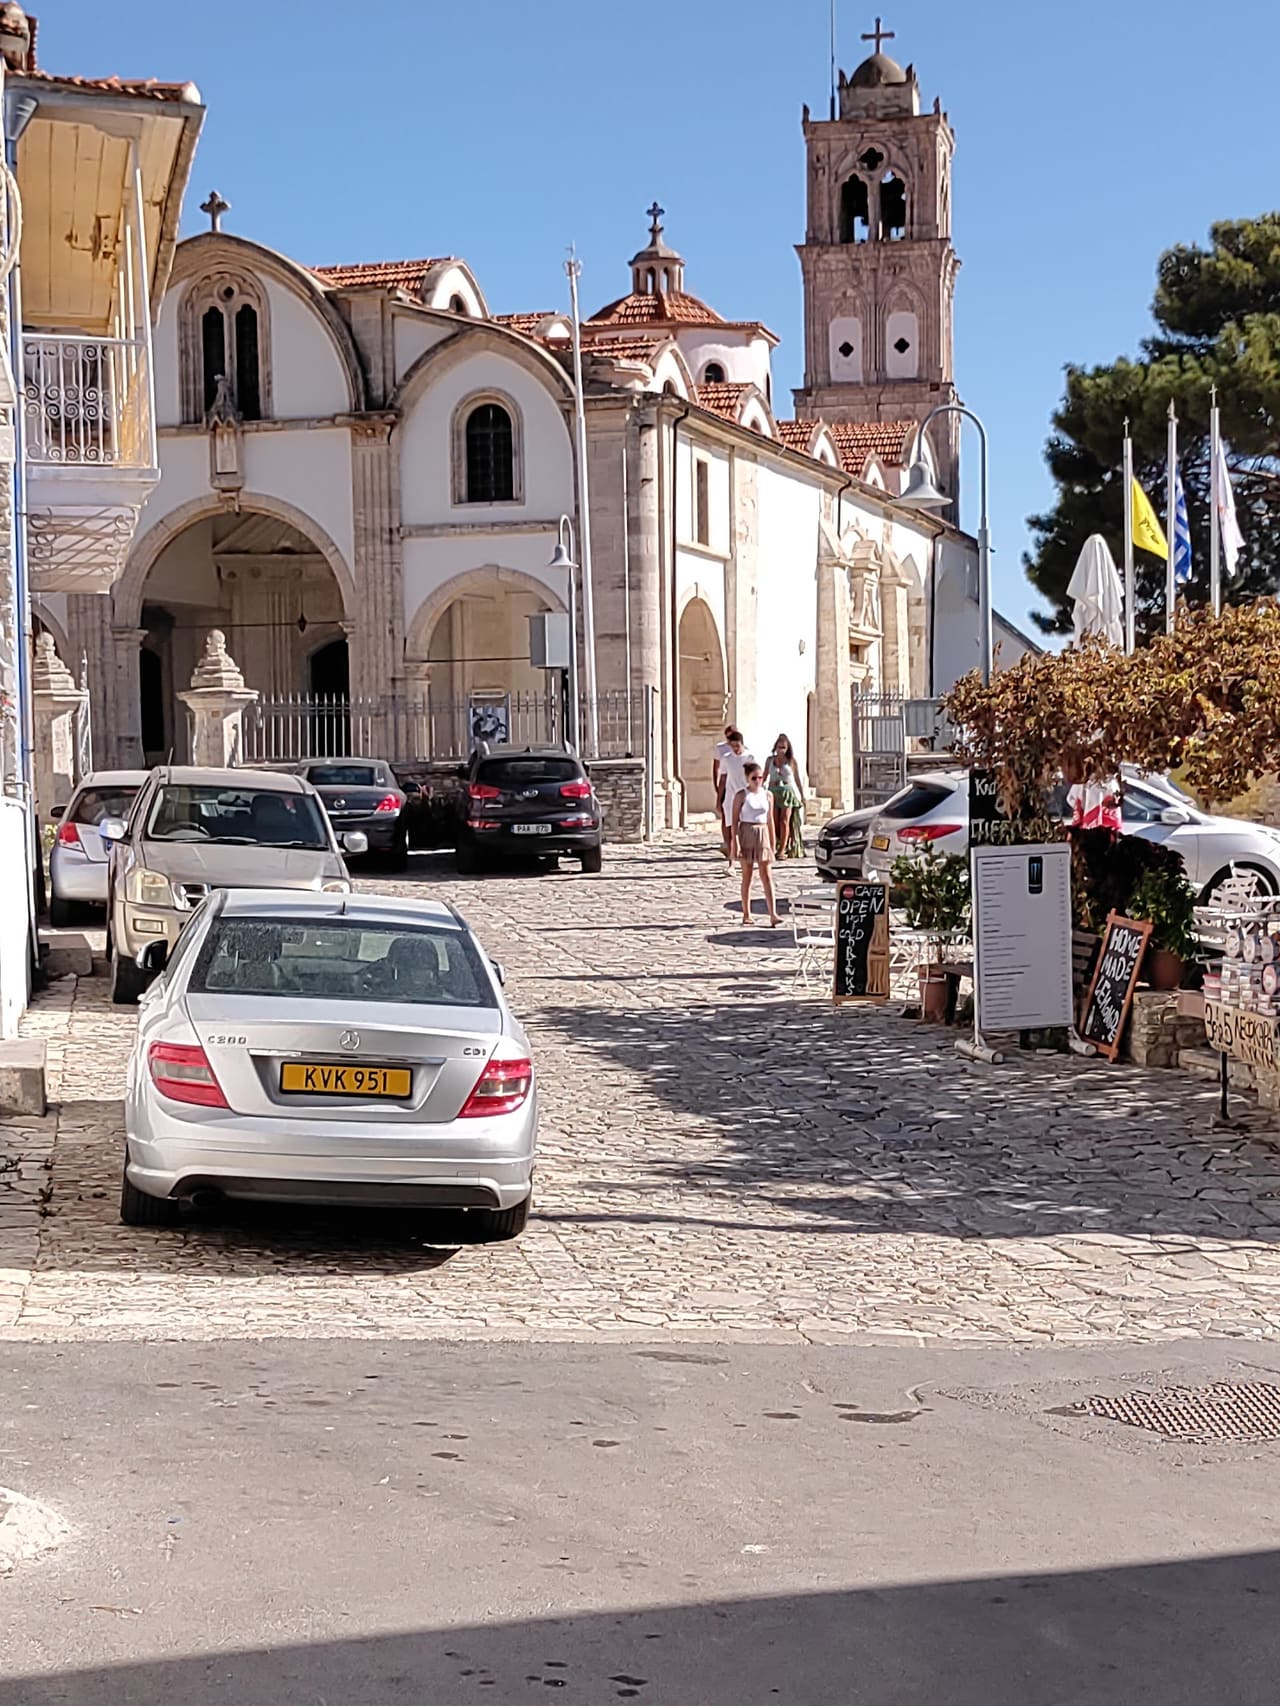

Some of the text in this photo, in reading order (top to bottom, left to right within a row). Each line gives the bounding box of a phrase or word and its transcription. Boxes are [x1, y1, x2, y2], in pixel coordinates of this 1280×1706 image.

[840, 897, 885, 914] OPEN
[846, 914, 867, 924] HOT
[1109, 927, 1143, 958] HOME
[845, 938, 857, 996] DRINKS
[1100, 953, 1135, 982] MADE
[207, 1034, 248, 1045] C200
[463, 1047, 487, 1057] CDI
[304, 1066, 389, 1093] KVK 951
